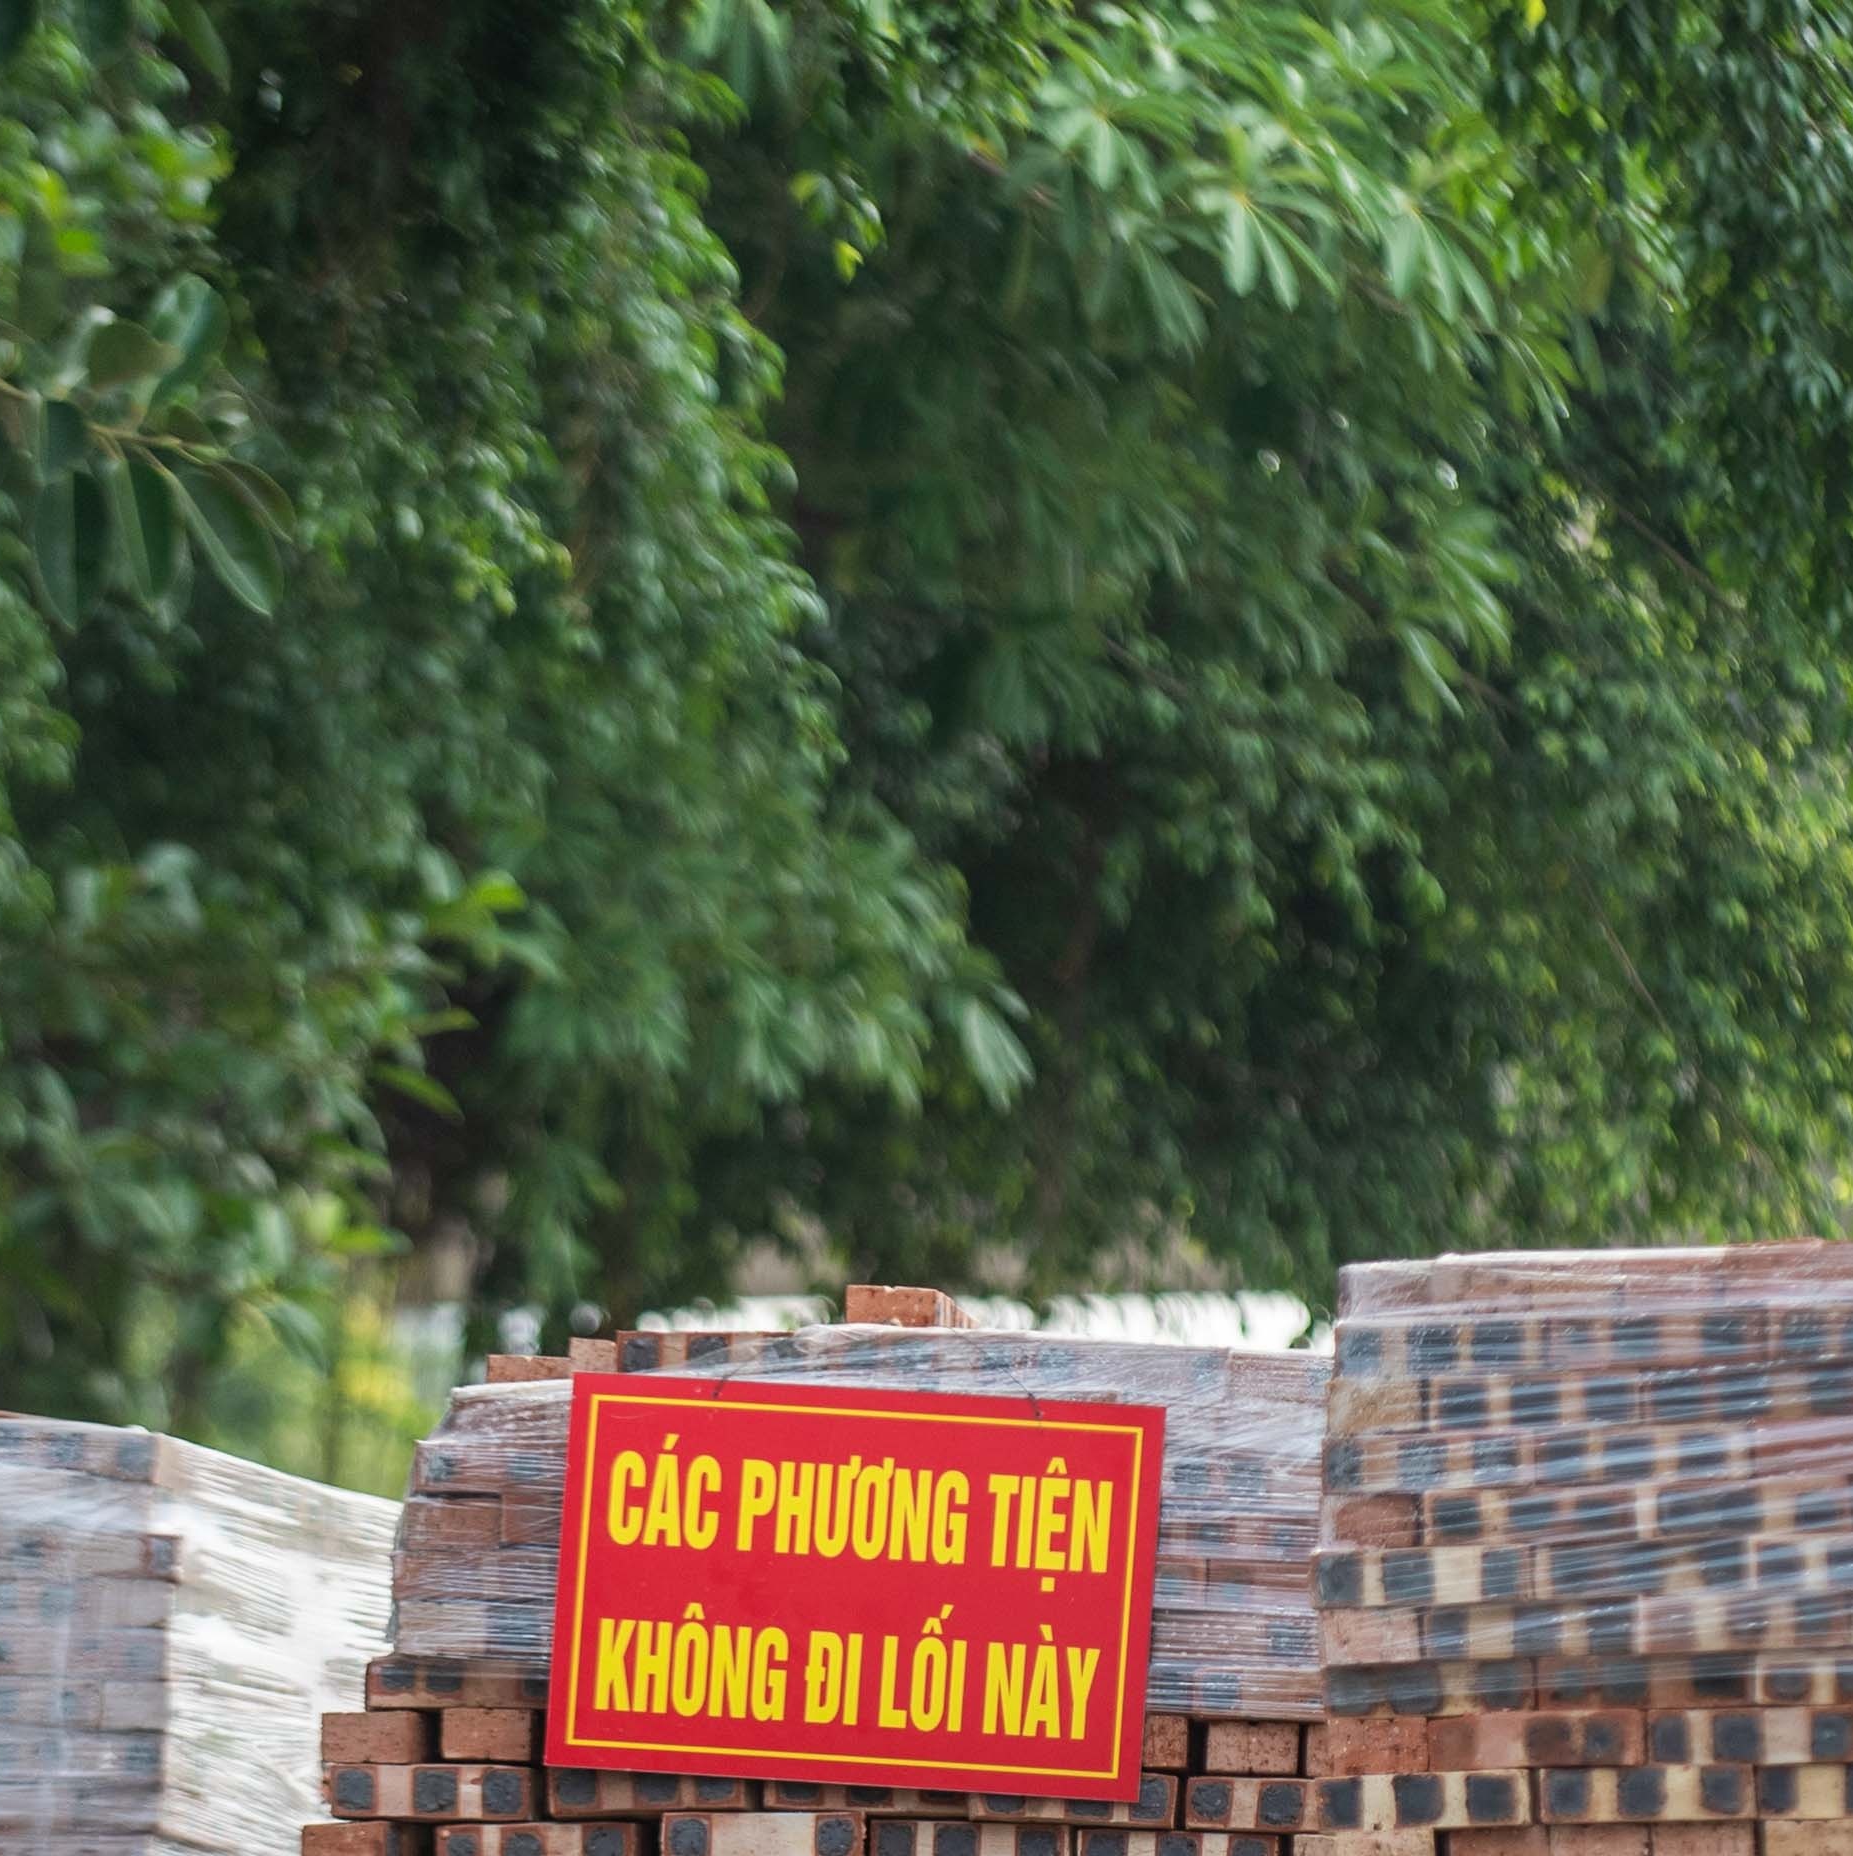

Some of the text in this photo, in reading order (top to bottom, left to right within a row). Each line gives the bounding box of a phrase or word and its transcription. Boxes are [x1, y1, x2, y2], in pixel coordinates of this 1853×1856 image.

[608, 1433, 1113, 1592] CÁC PHƯƠNG TIỆN
[594, 1603, 1100, 1739] KHÔNG ĐI LỐI NÀY
